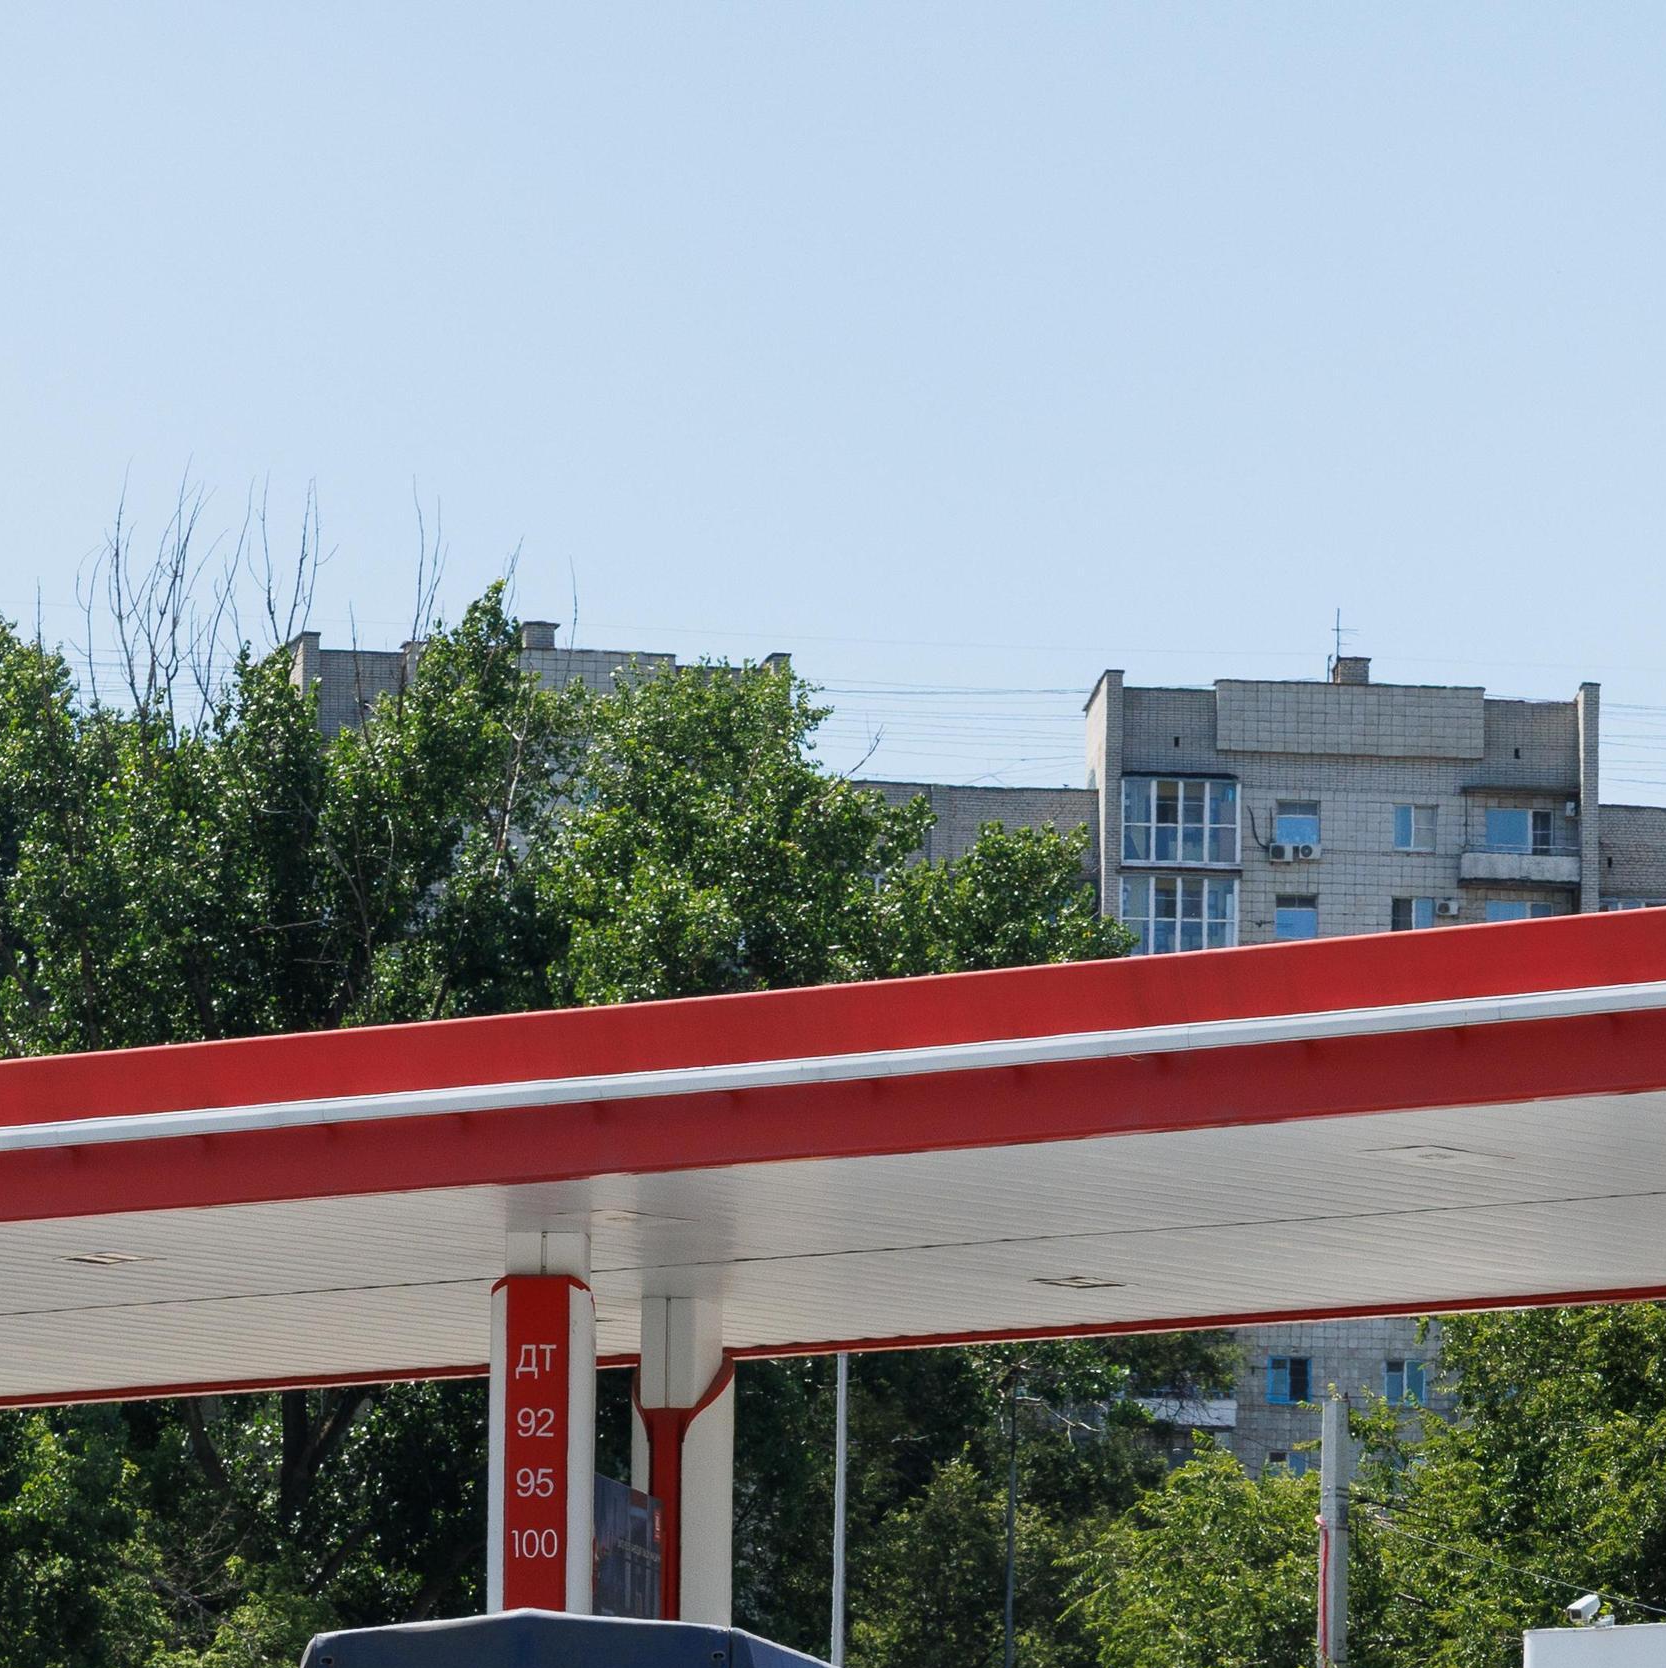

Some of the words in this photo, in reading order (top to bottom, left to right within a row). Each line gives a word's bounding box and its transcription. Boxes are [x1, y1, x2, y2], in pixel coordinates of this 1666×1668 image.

[515, 1344, 557, 1379] ДТ
[517, 1408, 555, 1437] 92
[516, 1468, 554, 1497] 95
[511, 1529, 558, 1558] 100
